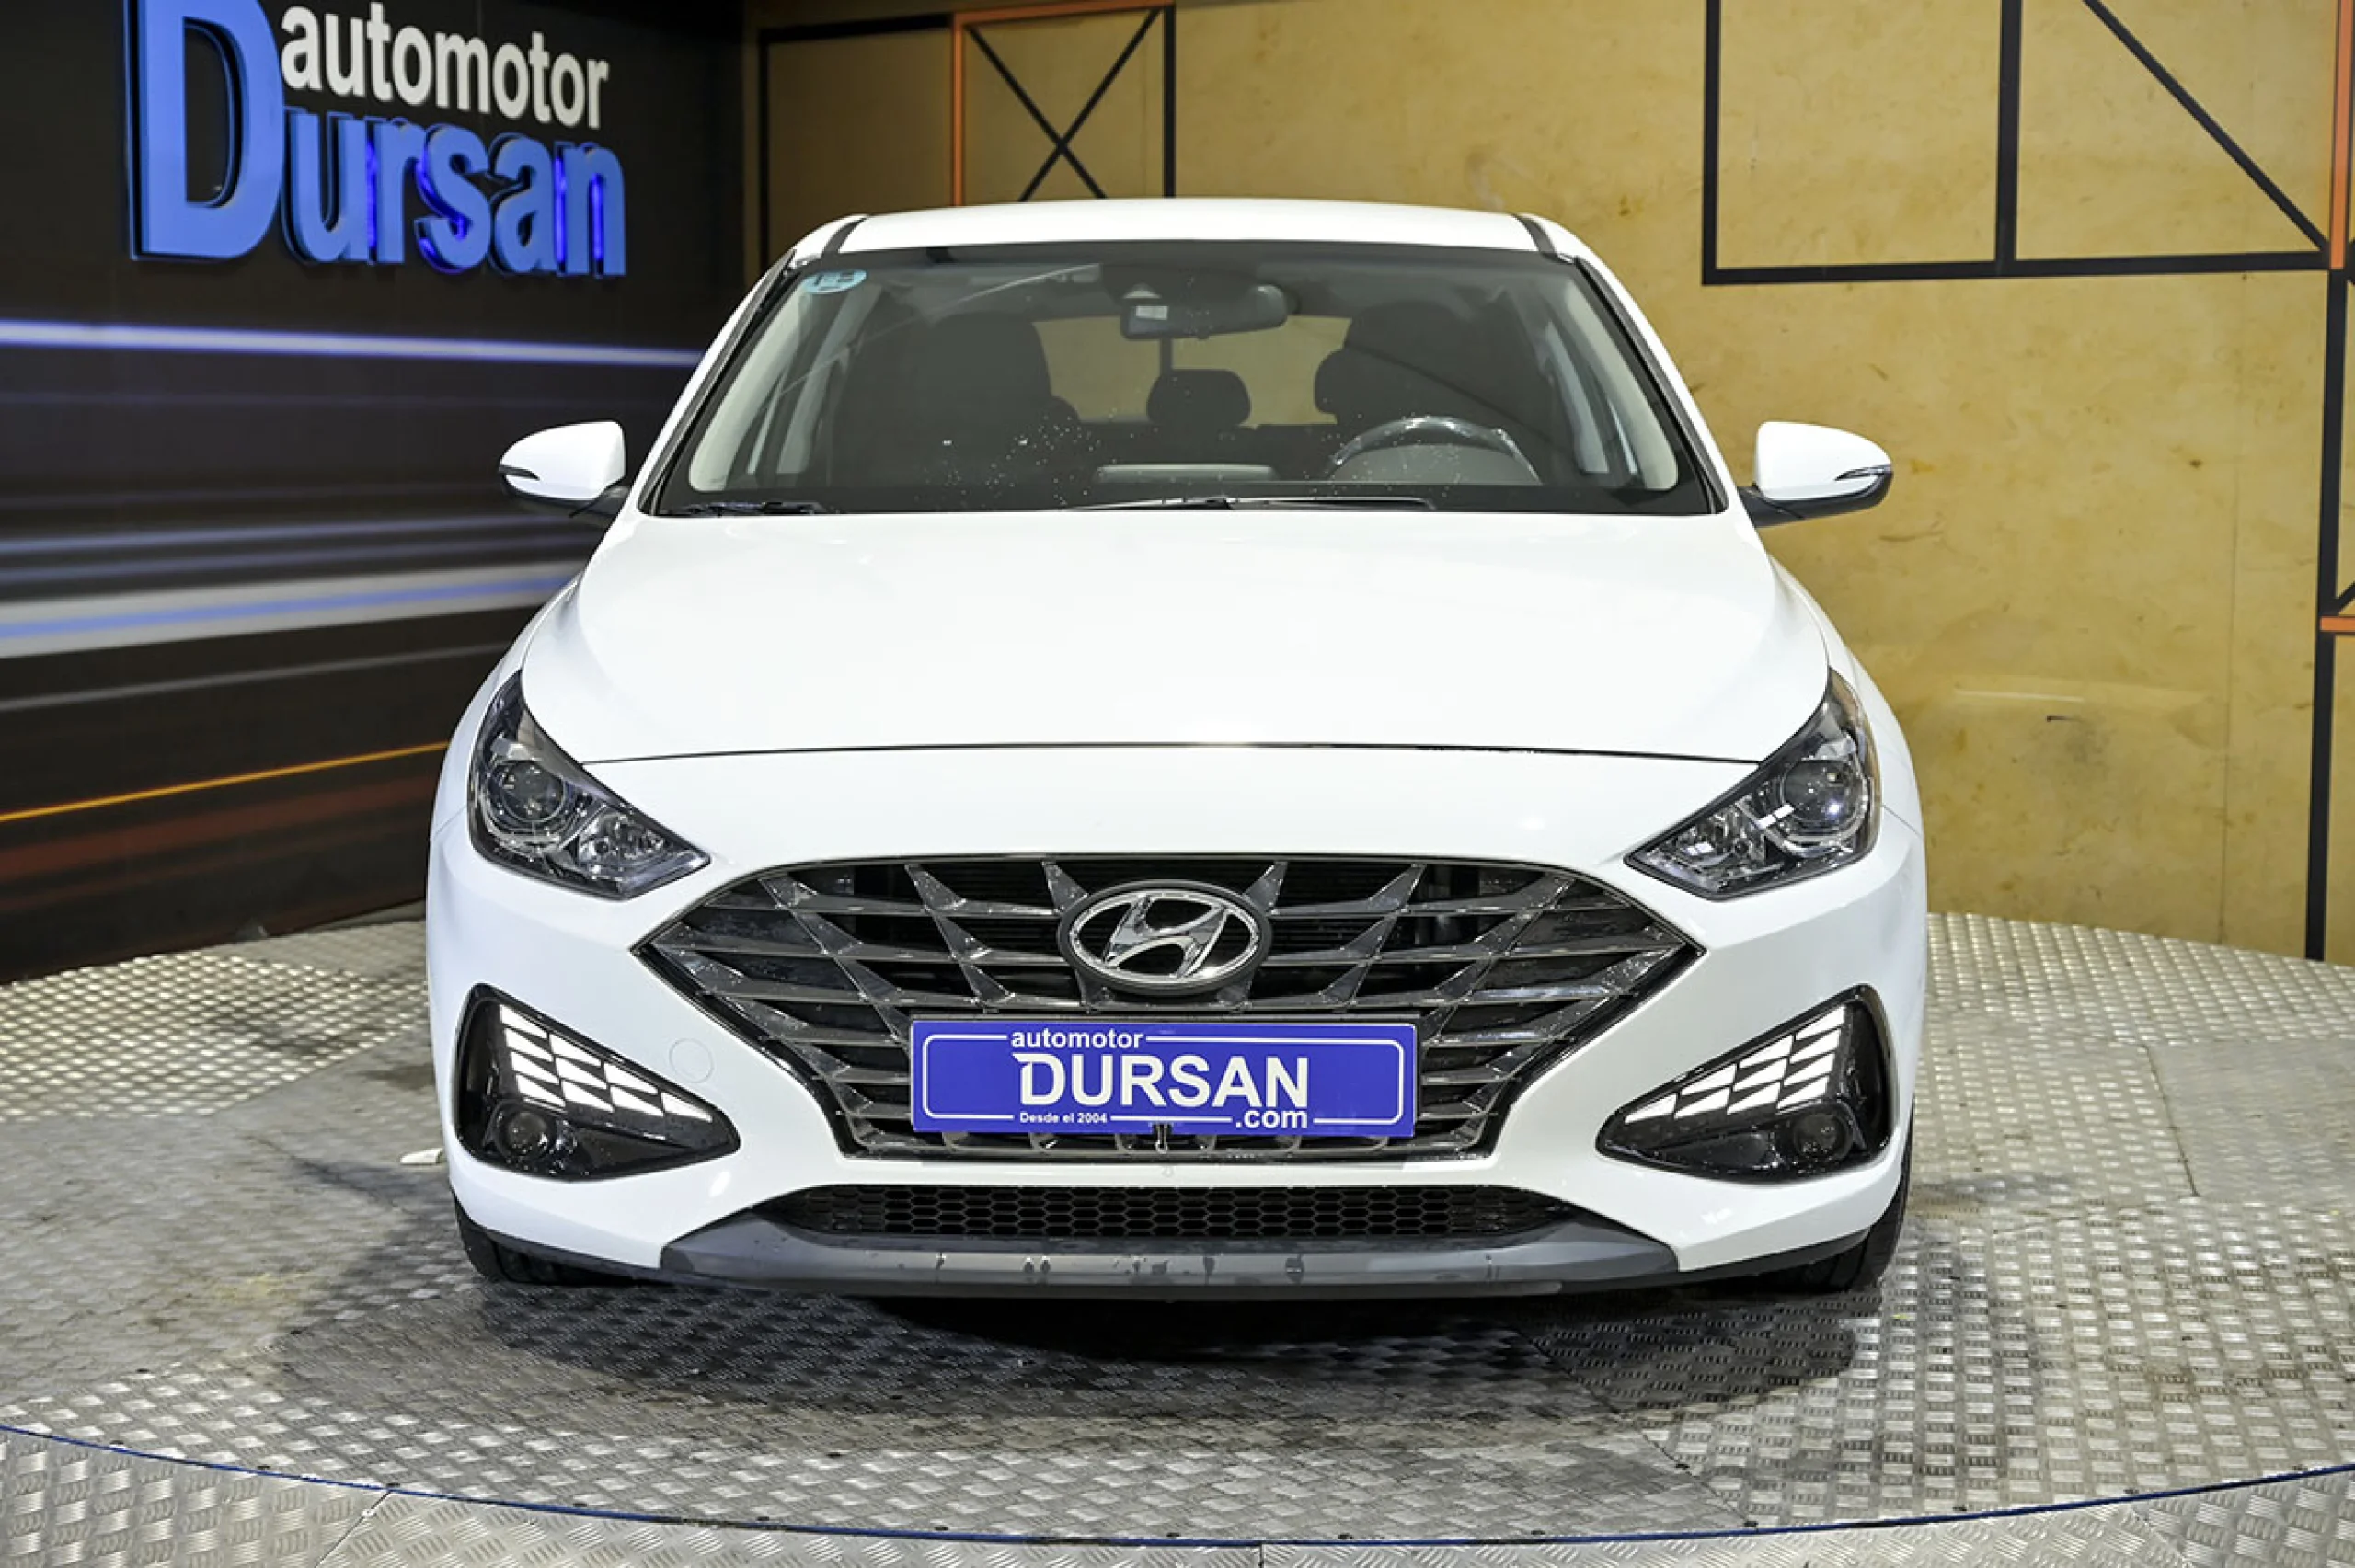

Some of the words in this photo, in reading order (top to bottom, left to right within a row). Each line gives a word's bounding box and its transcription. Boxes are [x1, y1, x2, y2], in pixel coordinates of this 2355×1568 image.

[281, 4, 610, 129] automotor
[129, 0, 626, 276] Dursan
[1012, 1028, 1143, 1048] automotor
[1012, 1052, 1309, 1108] DURSAN
[1019, 1111, 1060, 1124] Desde
[1063, 1111, 1074, 1124] el
[1077, 1112, 1108, 1124] 2004
[1235, 1108, 1308, 1130] .com
